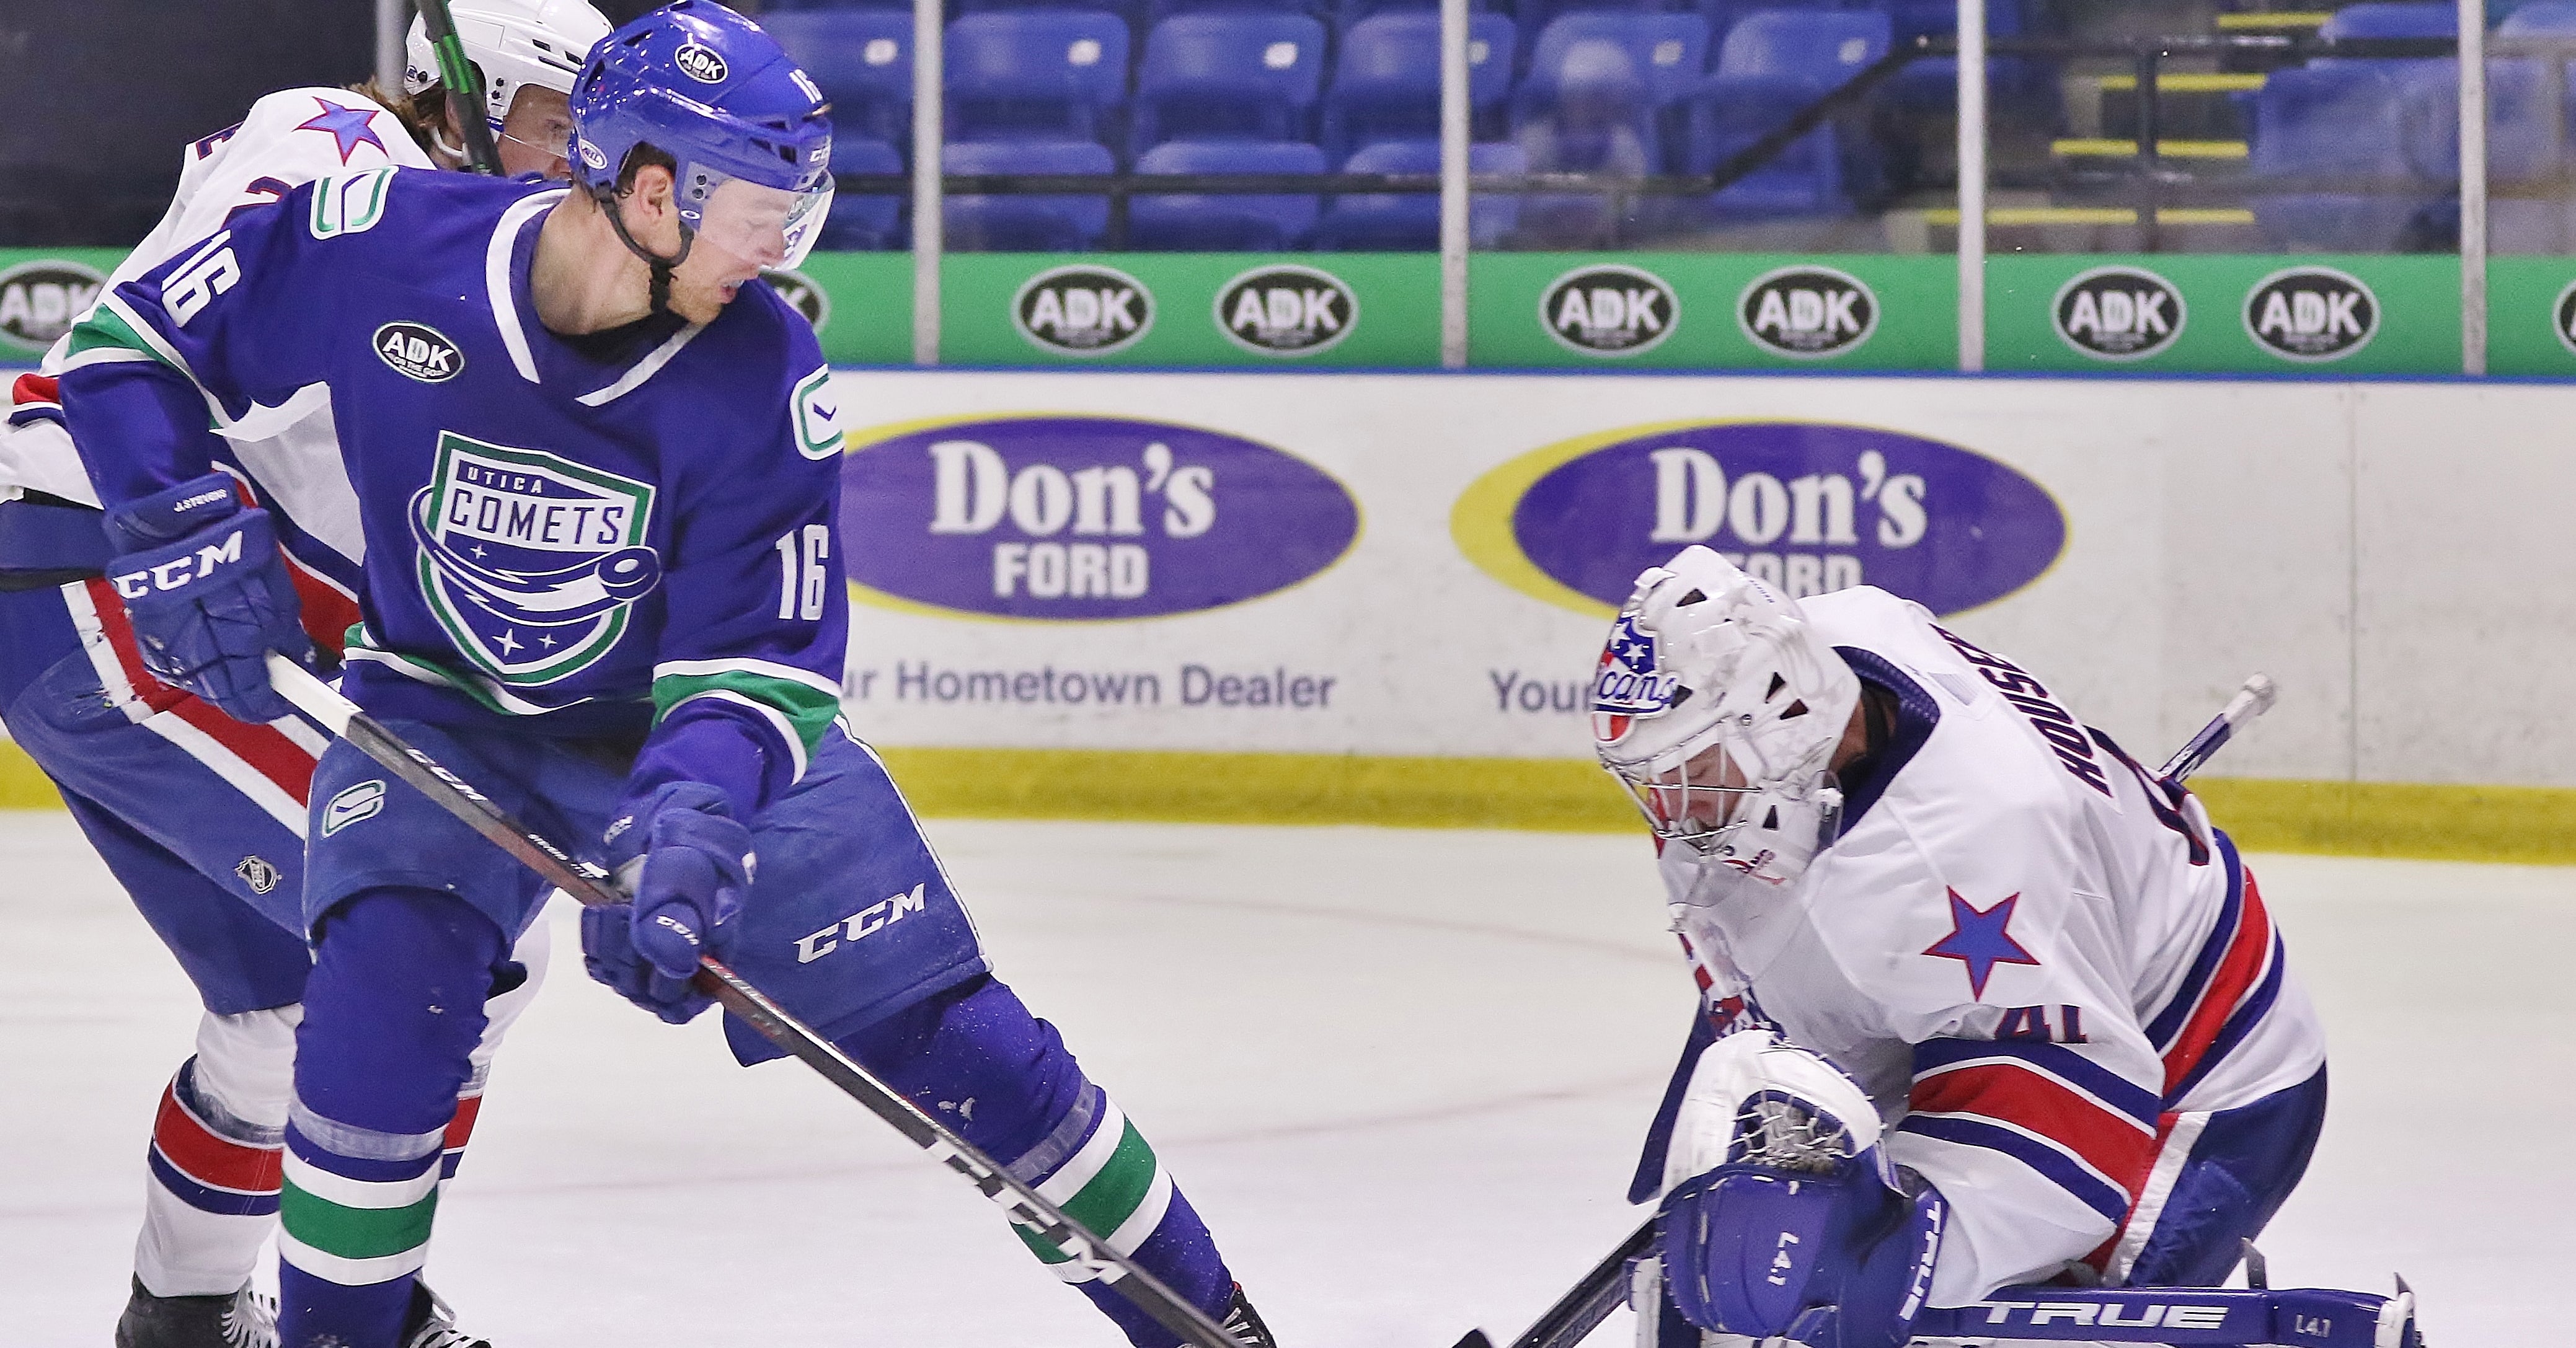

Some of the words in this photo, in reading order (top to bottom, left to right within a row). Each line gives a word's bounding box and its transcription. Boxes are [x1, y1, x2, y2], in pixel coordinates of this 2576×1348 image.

[679, 49, 723, 79] ADK
[161, 229, 241, 328] 16
[1030, 288, 1136, 332] ADK
[1230, 288, 1340, 332] ADK
[1556, 288, 1661, 332] ADK
[1753, 289, 1862, 333] ADK
[2068, 290, 2171, 335] ADK
[2259, 290, 2363, 336] ADK
[382, 331, 454, 372] ADK
[467, 466, 544, 494] UTICA
[928, 439, 1217, 539] Don's
[1650, 447, 1928, 548] Don's
[449, 488, 624, 544] COMETS
[112, 530, 244, 600] CCM
[775, 524, 830, 620] 16
[992, 542, 1150, 599] FORD
[1724, 552, 1862, 600] ORD
[897, 662, 1160, 705] Hometown
[1181, 666, 1337, 708] Dealer
[405, 747, 489, 801] CCM
[793, 883, 926, 964] CCM
[1994, 1004, 2089, 1043] 41
[925, 1134, 1131, 1285] CCM
[1767, 1231, 1799, 1286] L4.1
[1898, 1200, 1942, 1321] TRUE
[1980, 1302, 2229, 1329] TRUE
[2295, 1313, 2332, 1339] L4.1
